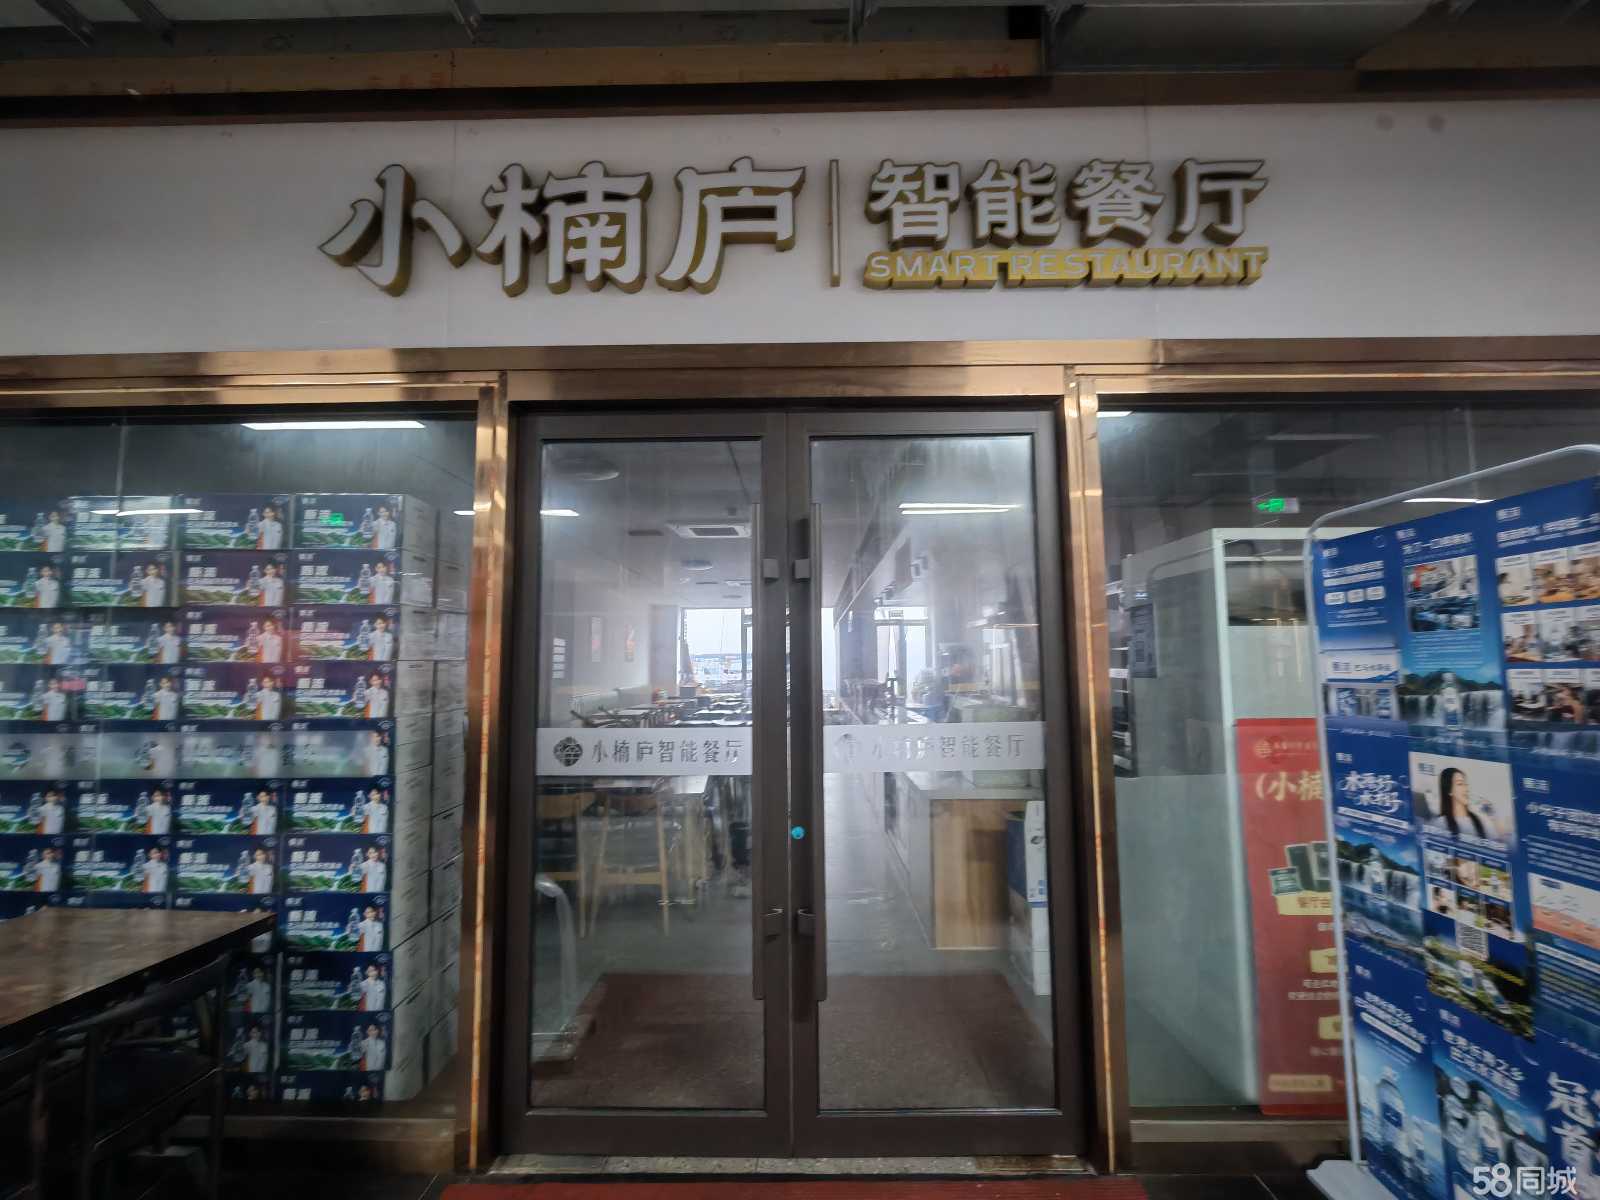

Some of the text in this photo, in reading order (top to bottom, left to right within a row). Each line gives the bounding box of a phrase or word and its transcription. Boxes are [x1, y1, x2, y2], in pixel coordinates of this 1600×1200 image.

[318, 156, 1271, 298] 小楠庐 智能餐厅
[866, 246, 1269, 288] SMART RESTAURANT
